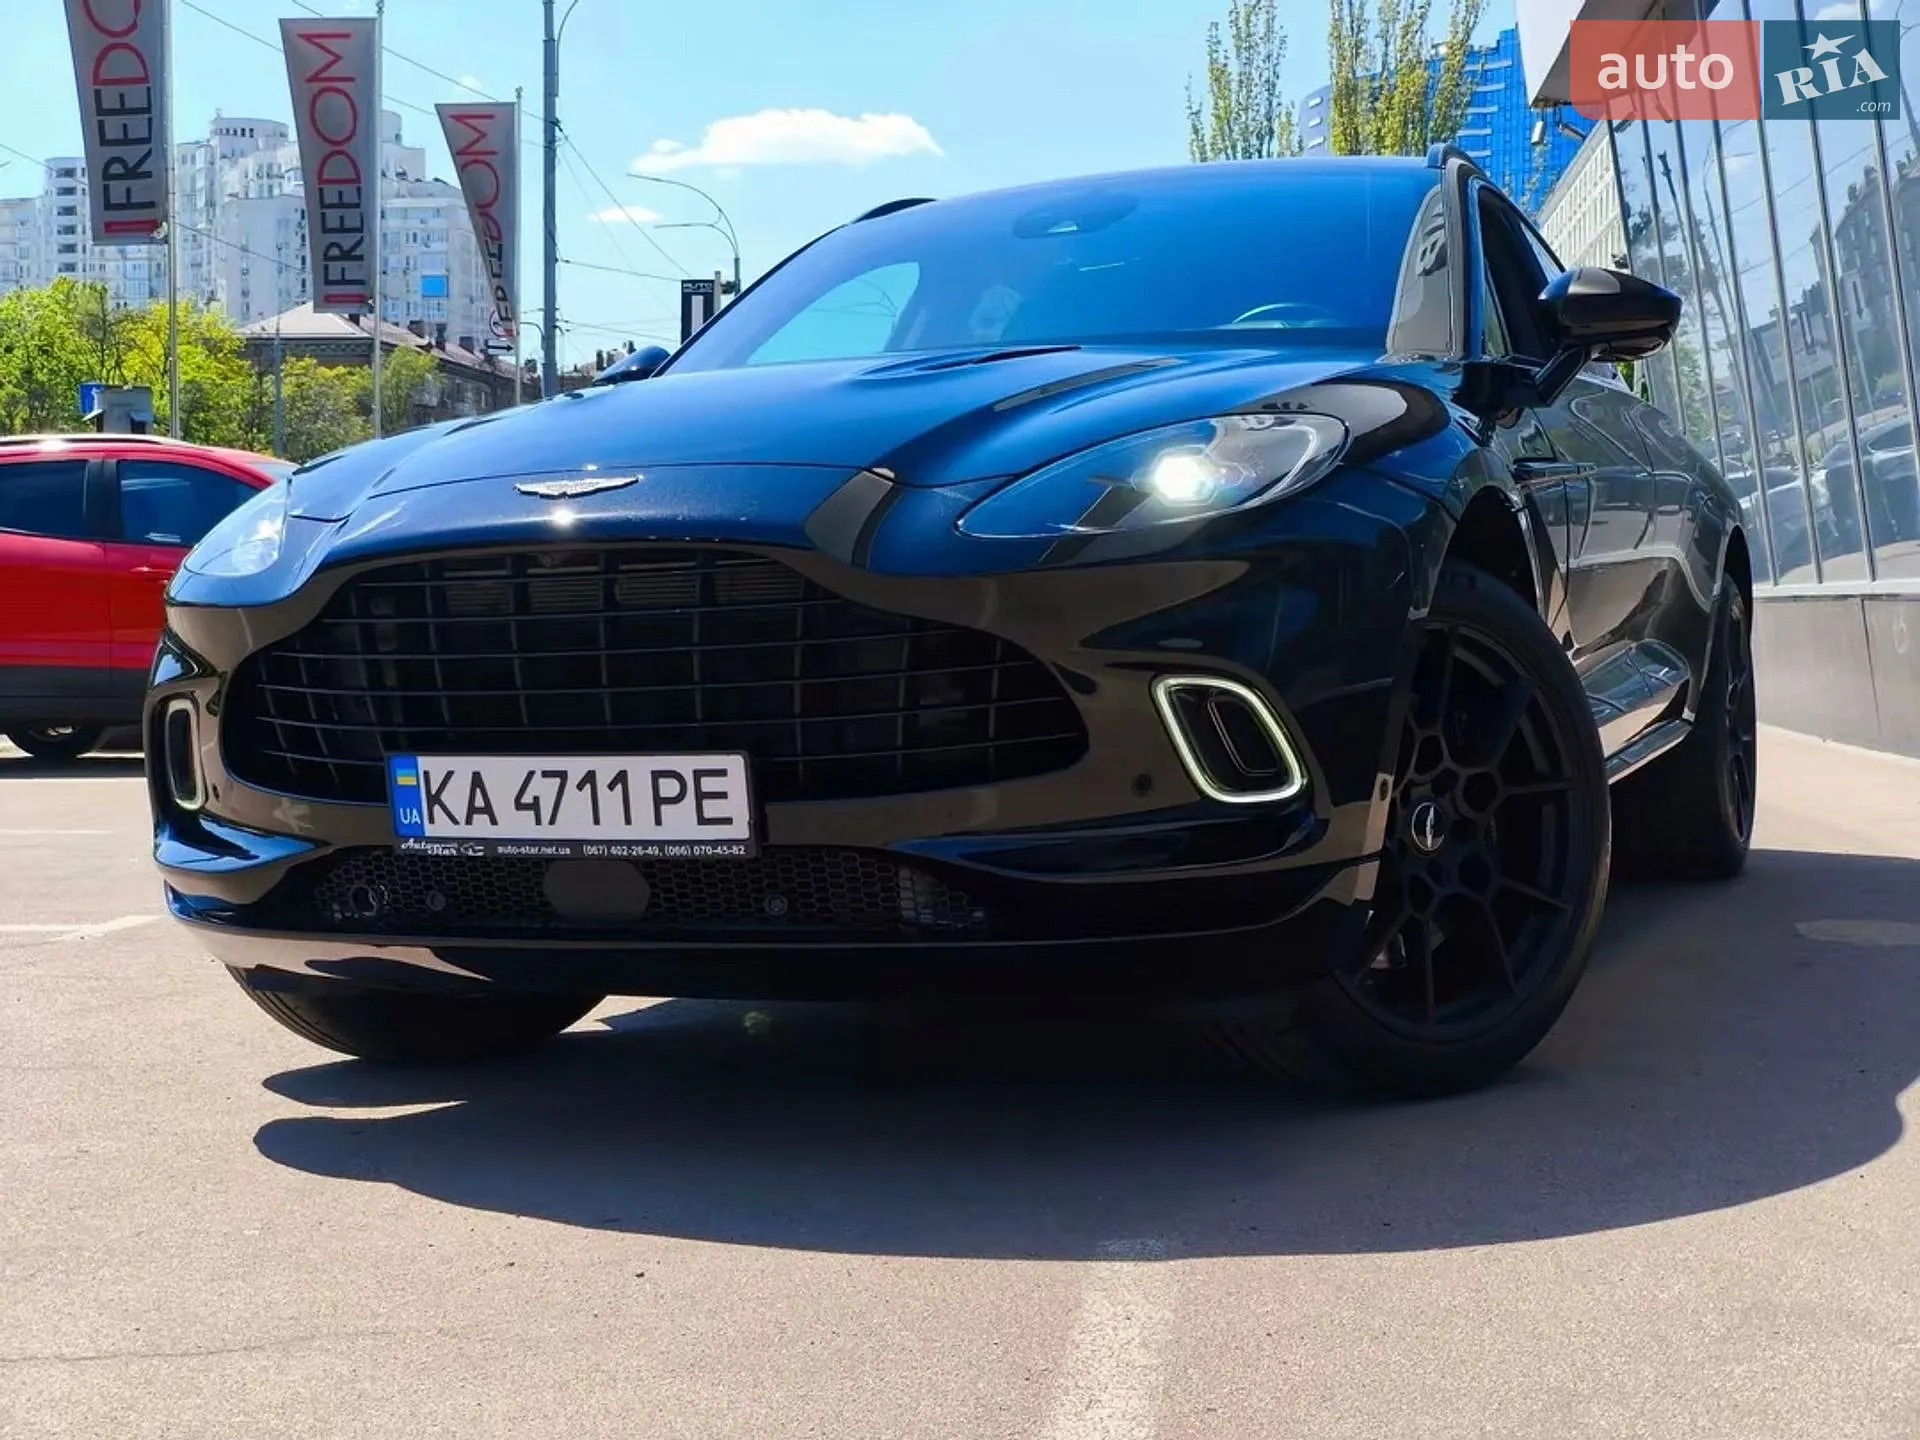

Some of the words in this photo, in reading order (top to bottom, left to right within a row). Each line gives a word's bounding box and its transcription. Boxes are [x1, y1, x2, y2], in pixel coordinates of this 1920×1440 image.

[297, 32, 366, 287] FREEDOM
[400, 808, 421, 825] UA
[423, 770, 499, 827] KA
[513, 769, 633, 827] 4711
[650, 768, 734, 827] PE
[497, 845, 572, 856] auto-star.net.ua
